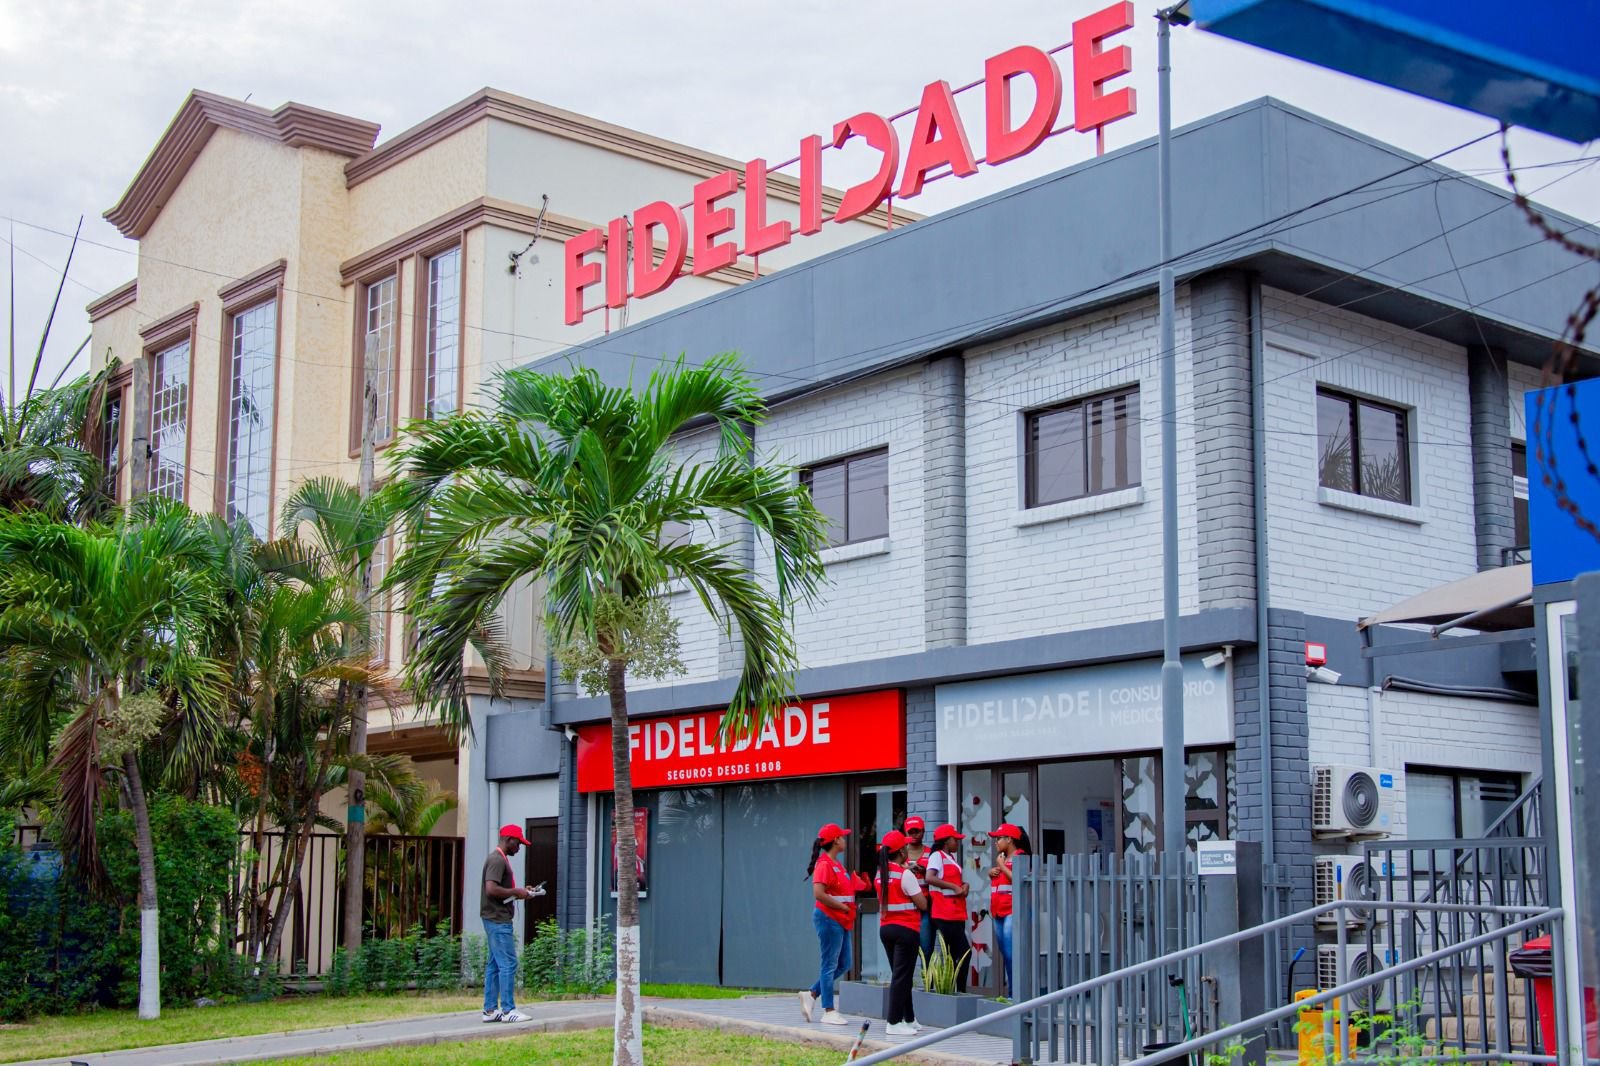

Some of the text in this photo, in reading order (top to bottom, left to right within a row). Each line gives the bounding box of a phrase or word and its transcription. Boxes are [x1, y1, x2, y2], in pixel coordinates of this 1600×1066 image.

[565, 1, 1136, 325] FIDELIDADE
[944, 690, 1090, 730] FIDELIDADE
[667, 761, 782, 780] SEGUROS DESDE 1808
